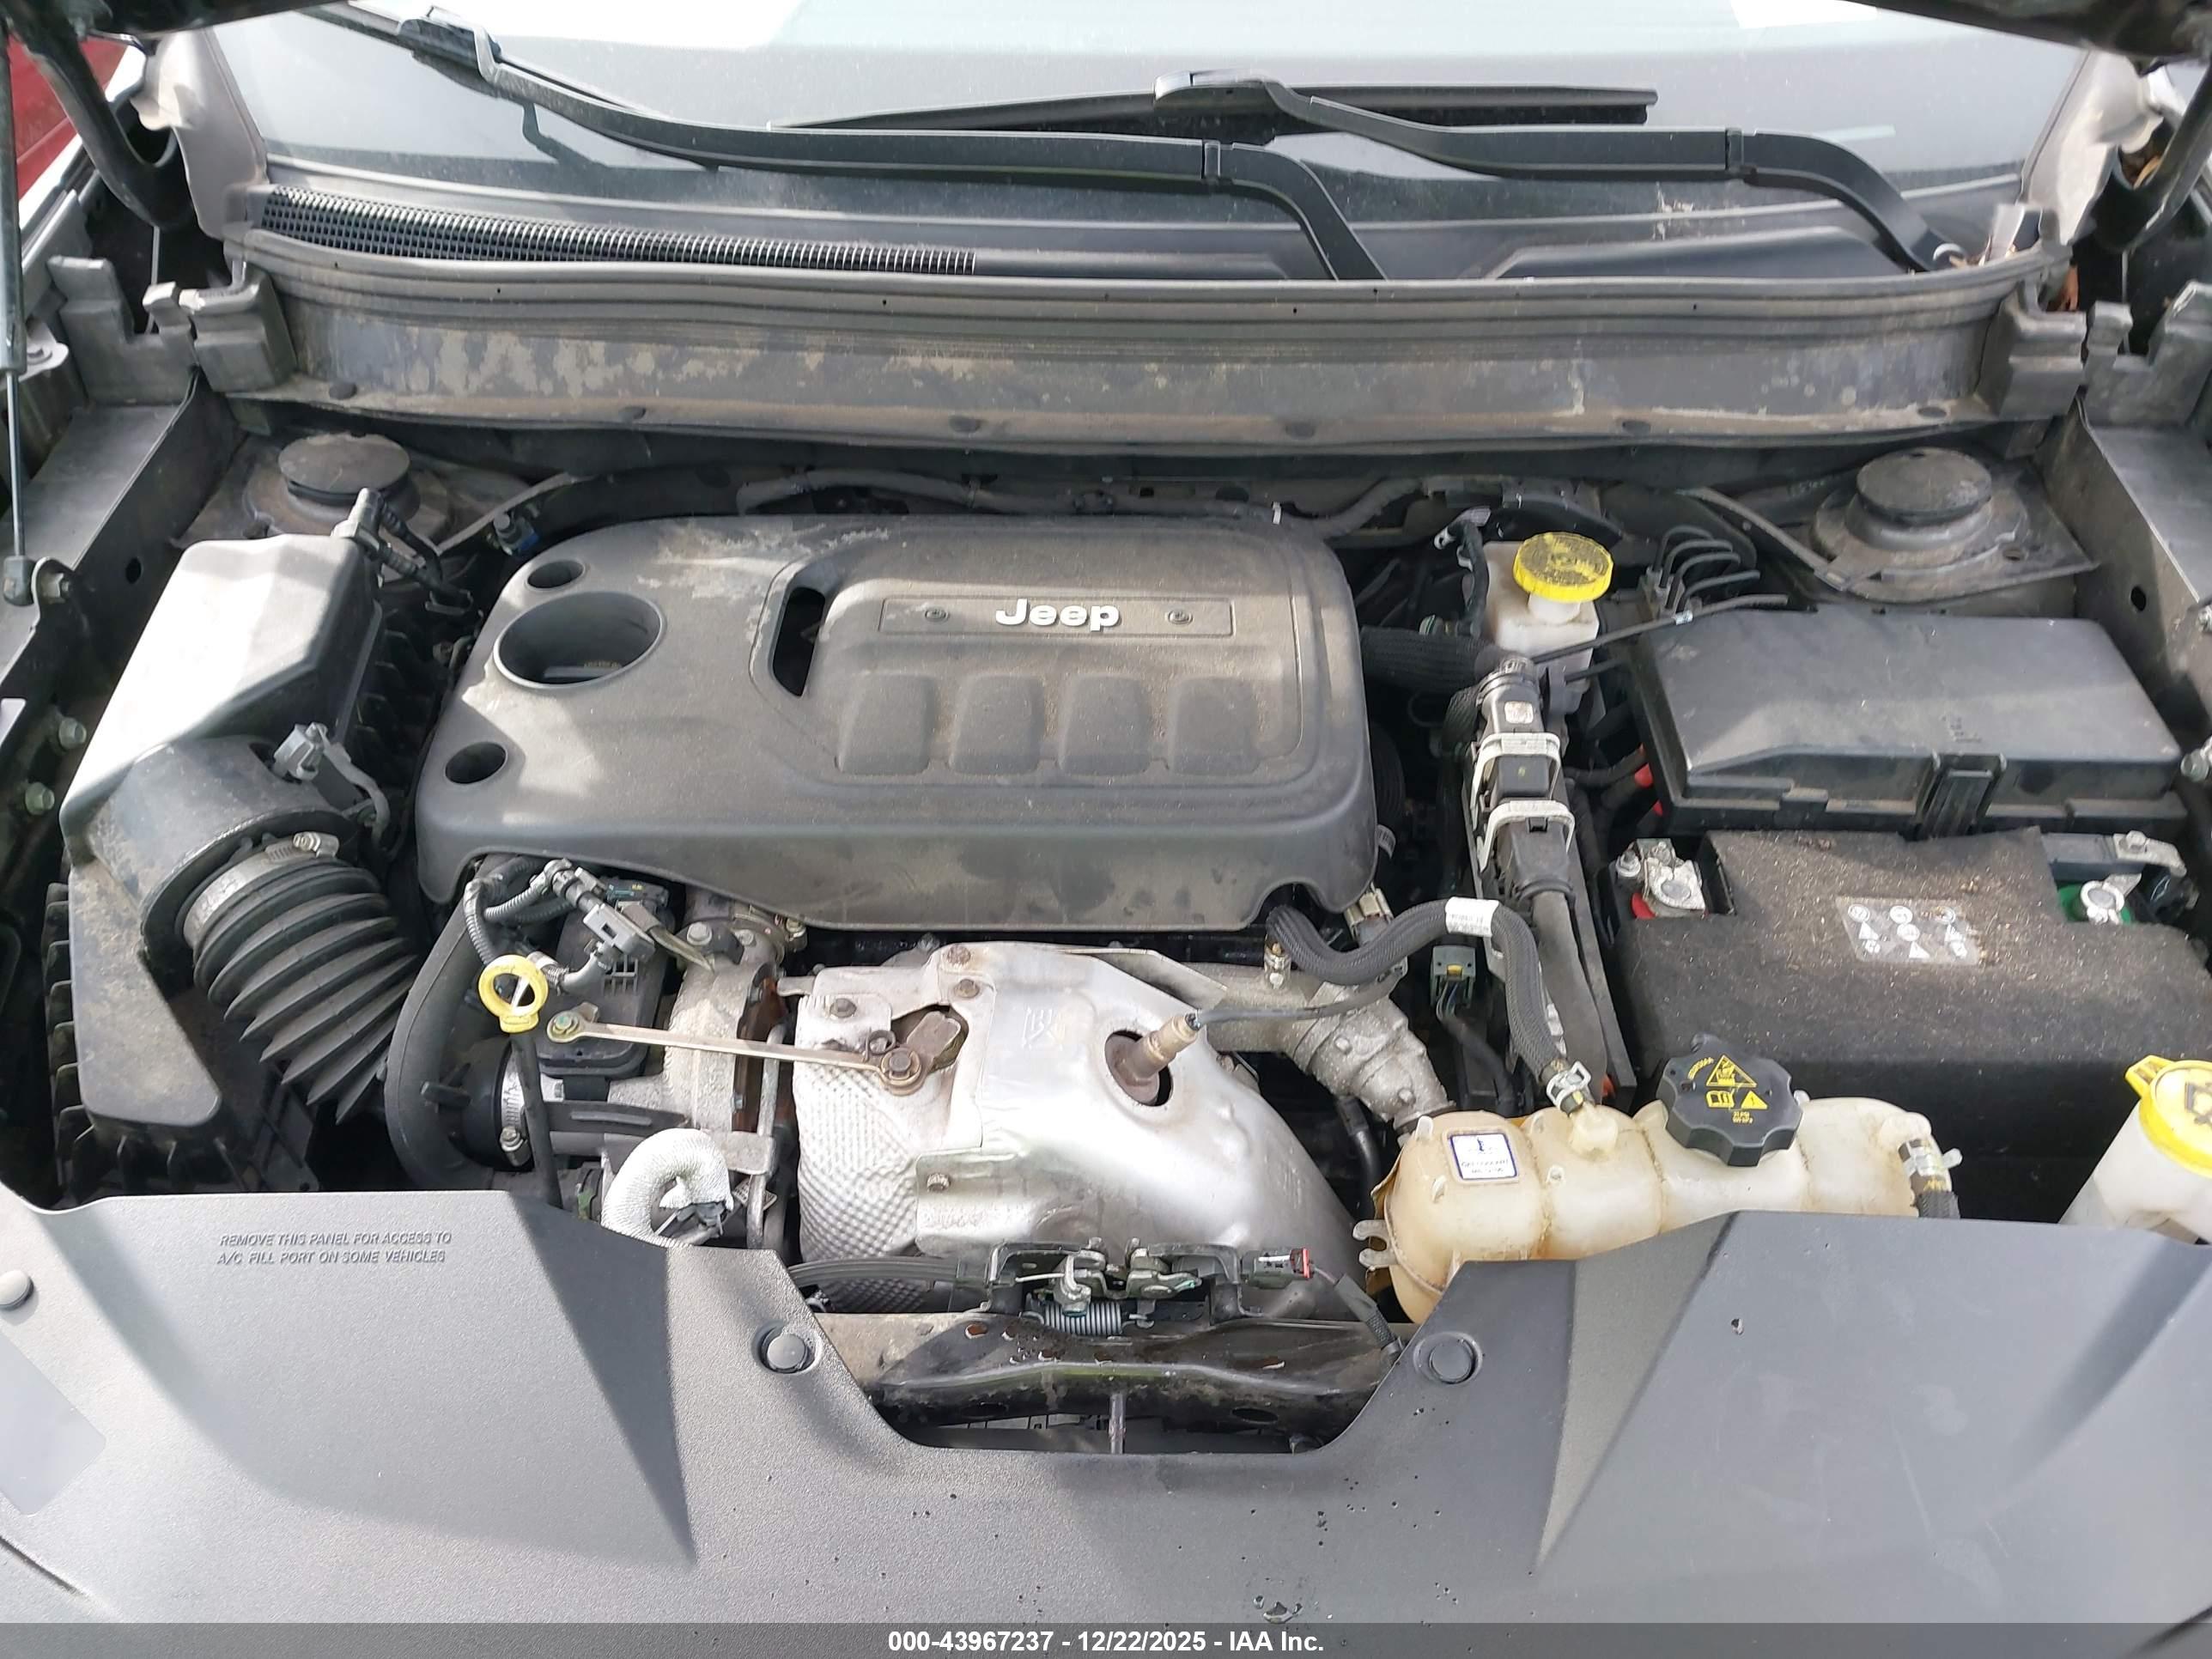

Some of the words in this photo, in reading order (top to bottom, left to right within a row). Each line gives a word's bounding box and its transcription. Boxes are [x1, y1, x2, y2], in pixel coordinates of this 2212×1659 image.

[995, 598, 1121, 632] Jeep
[220, 1233, 274, 1245] REMOVE
[277, 1233, 306, 1245] THIS
[309, 1233, 349, 1245] PANEL
[353, 1232, 380, 1244] FOR
[382, 1231, 431, 1244] ACCESS
[435, 1231, 452, 1243] TO
[217, 1251, 242, 1265] A/C
[249, 1251, 274, 1264] FILL
[280, 1250, 315, 1264] PORT
[319, 1250, 339, 1263] ON
[343, 1250, 380, 1263] SOME
[386, 1249, 446, 1262] VEHICLES
